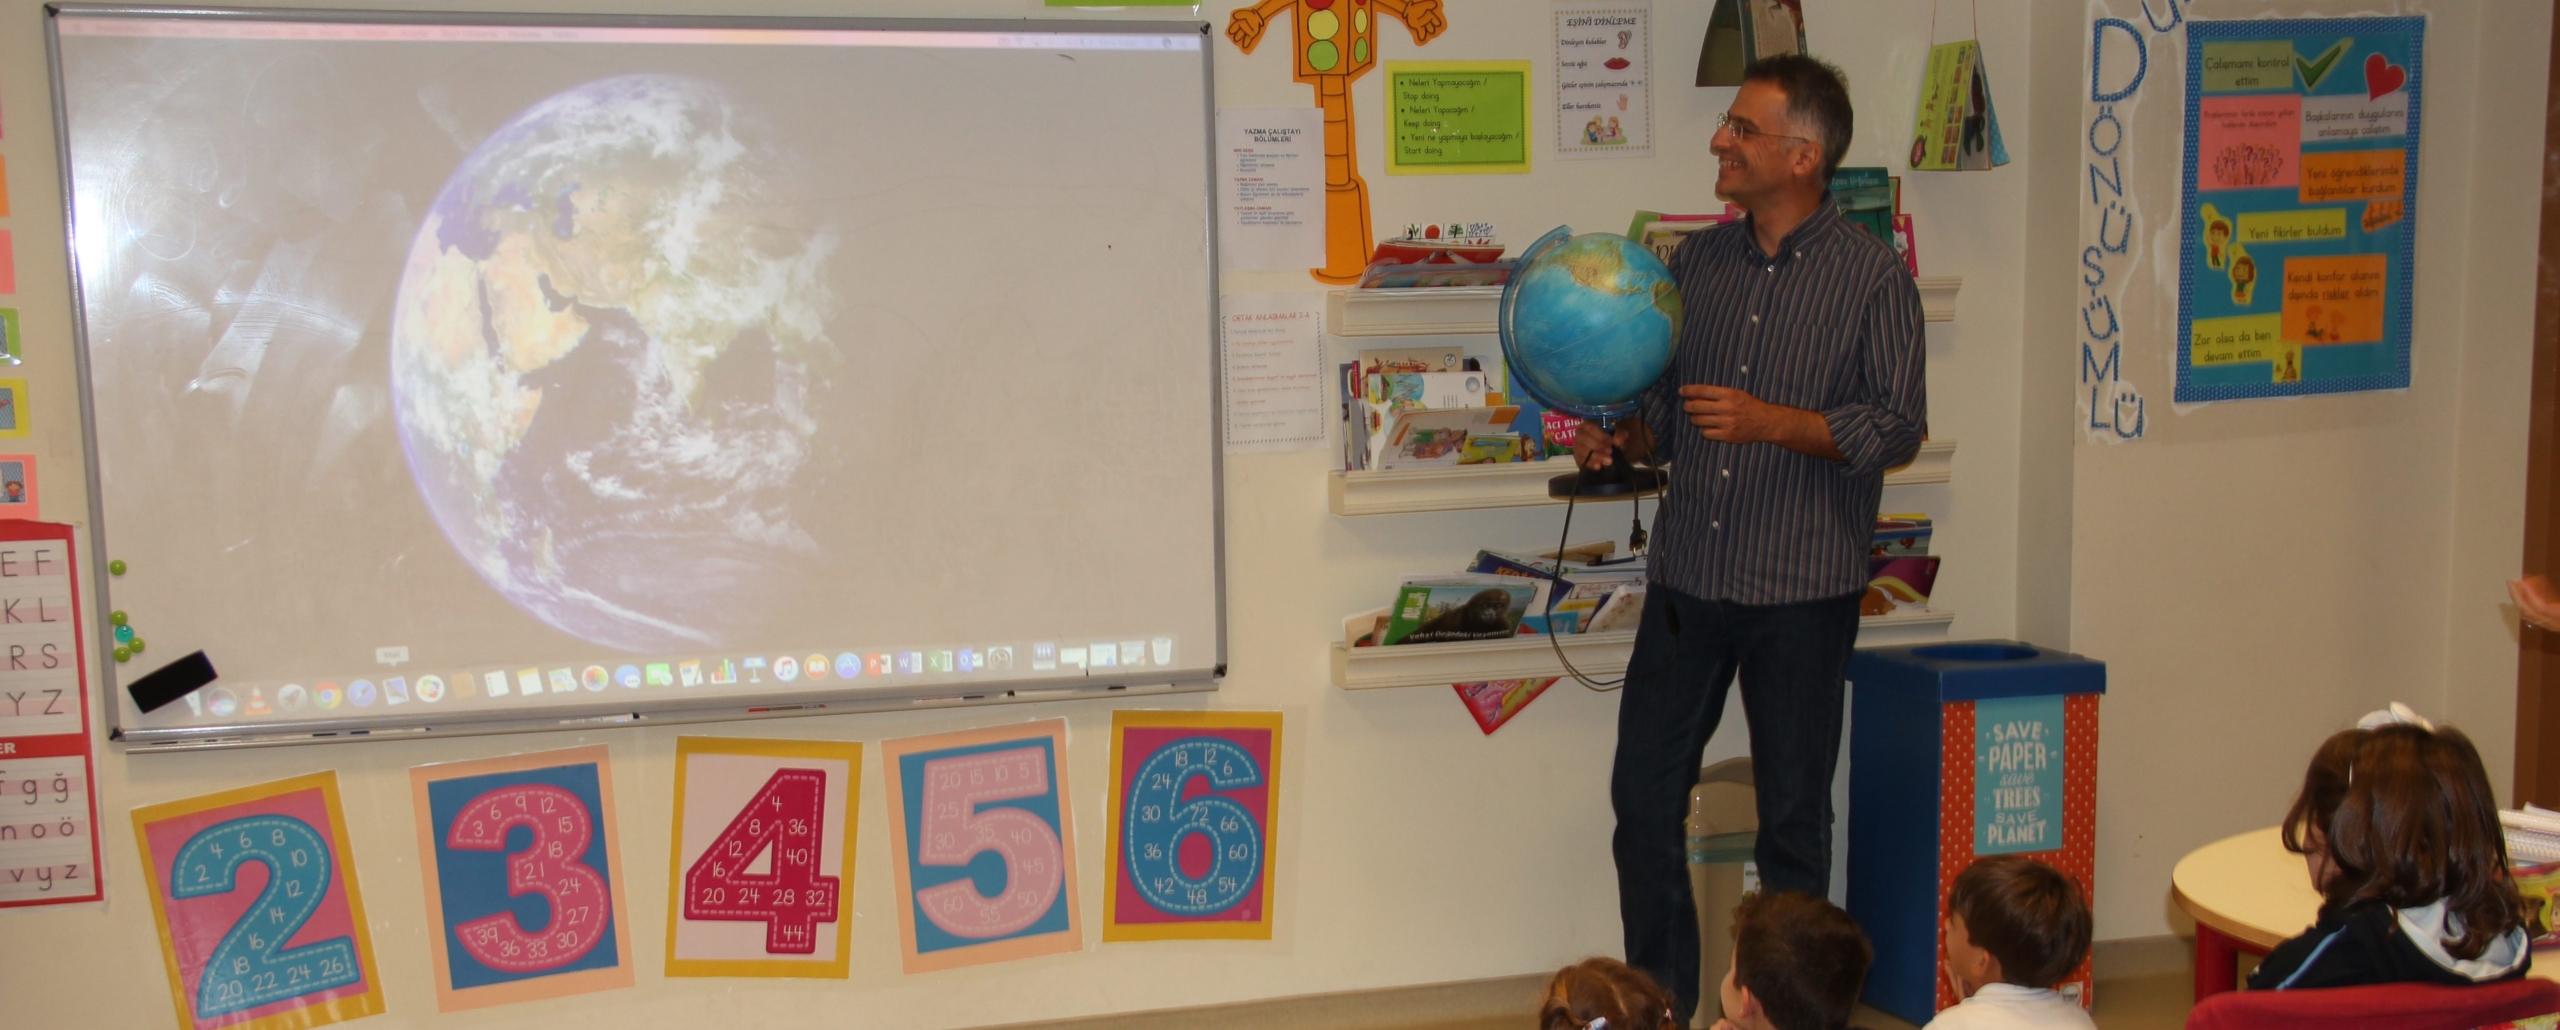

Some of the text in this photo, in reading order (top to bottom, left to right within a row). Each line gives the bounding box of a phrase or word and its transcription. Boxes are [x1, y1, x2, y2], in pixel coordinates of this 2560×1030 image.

[1594, 16, 1637, 25] DİNLEME
[2205, 56, 2289, 71] Çalışmamı kontrol
[2235, 76, 2259, 86] ettim
[1403, 92, 1439, 102] Stop doing
[1410, 106, 1430, 114] Neleri
[1404, 120, 1440, 129] Keep doing
[2317, 124, 2391, 138] anlamaya çalıştım
[1438, 134, 1468, 143] yapmaya
[1404, 146, 1442, 156] Start doing
[2307, 166, 2399, 183] Yeni öğrendiklerimle
[2309, 183, 2395, 201] bağlantılar kurdum
[2250, 224, 2341, 239] Yeni fikirler buldum
[2288, 270, 2379, 282] Kendi konfor alanım
[2288, 286, 2378, 301] dışında riskler aldım
[2194, 329, 2271, 345] Zor olsa da ben
[2204, 348, 2261, 362] devam ettim
[1546, 422, 1561, 430] ACI
[1, 549, 52, 577] E F
[5, 597, 57, 623] K L
[11, 643, 58, 670] R S
[6, 690, 64, 716] Y Z
[1993, 721, 2042, 742] SAVE
[1175, 748, 1233, 775] 18 12 6
[1989, 741, 2046, 772] PAPER
[940, 763, 1029, 791] 20 15 10 5
[1152, 774, 1172, 789] 24
[2001, 772, 2034, 786] save
[22, 773, 69, 804] g ğ
[772, 796, 782, 812] 4
[1993, 786, 2040, 809] TREES
[473, 796, 556, 837] 3 6 9 12
[938, 802, 959, 820] 25
[1142, 805, 1209, 823] 30 72
[1996, 810, 2037, 824] SAVE
[1, 817, 75, 840] n o ö
[558, 817, 573, 833] 15
[750, 819, 807, 835] 8 36
[1123, 735, 1264, 917] 6
[1221, 816, 1238, 832] 66
[1988, 819, 2046, 845] PLANET
[916, 745, 1064, 939] 5
[936, 833, 955, 851] 30
[976, 823, 1032, 845] 35 40
[195, 829, 285, 882] 2 4 6 8
[291, 849, 307, 866] 10
[549, 841, 564, 858] 18
[729, 841, 808, 866] 12 40
[1144, 844, 1248, 860] 36 60
[684, 768, 839, 954] 4
[713, 861, 725, 878] 16
[1024, 857, 1044, 874] 45
[10, 863, 78, 891] v y z
[446, 783, 611, 973] 3
[524, 862, 544, 880] 21
[286, 880, 303, 897] 12
[559, 878, 581, 895] 24
[1155, 877, 1237, 894] 42 54
[703, 888, 825, 906] 20 24 28 32
[944, 891, 1038, 913] 60 50
[1187, 889, 1207, 905] 48
[171, 814, 361, 1020] 2
[270, 907, 285, 924] 14
[567, 906, 589, 925] 27
[980, 907, 1000, 925] 55
[250, 933, 265, 949] 16
[783, 925, 804, 941] 44
[477, 927, 578, 958] 39 36 33 30
[233, 957, 250, 975] 18
[218, 957, 343, 1000] 20 22 24 26
